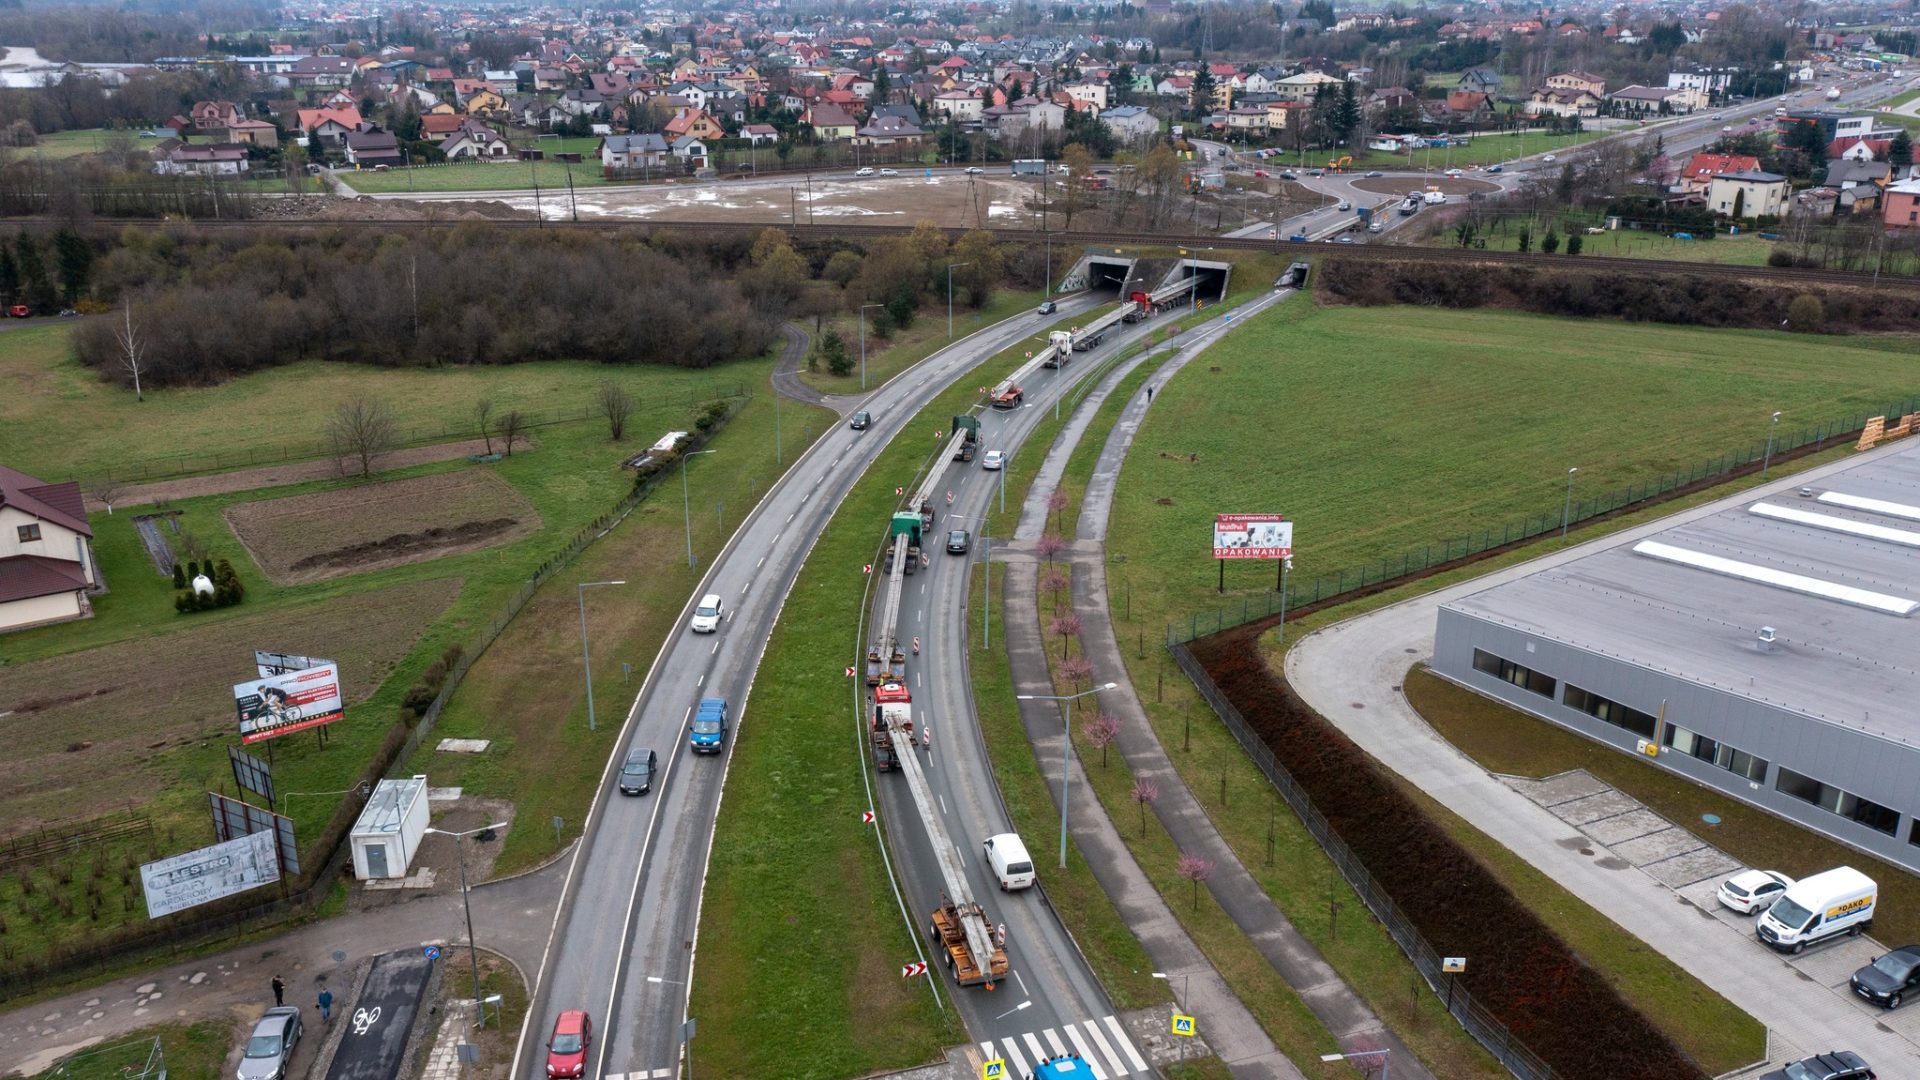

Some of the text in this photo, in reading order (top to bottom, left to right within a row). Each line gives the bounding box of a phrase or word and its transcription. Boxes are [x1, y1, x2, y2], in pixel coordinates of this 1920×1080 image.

[165, 879, 206, 898] SZAFY
[153, 887, 213, 910] GARDEROBY
[1842, 899, 1863, 911] DAKO
